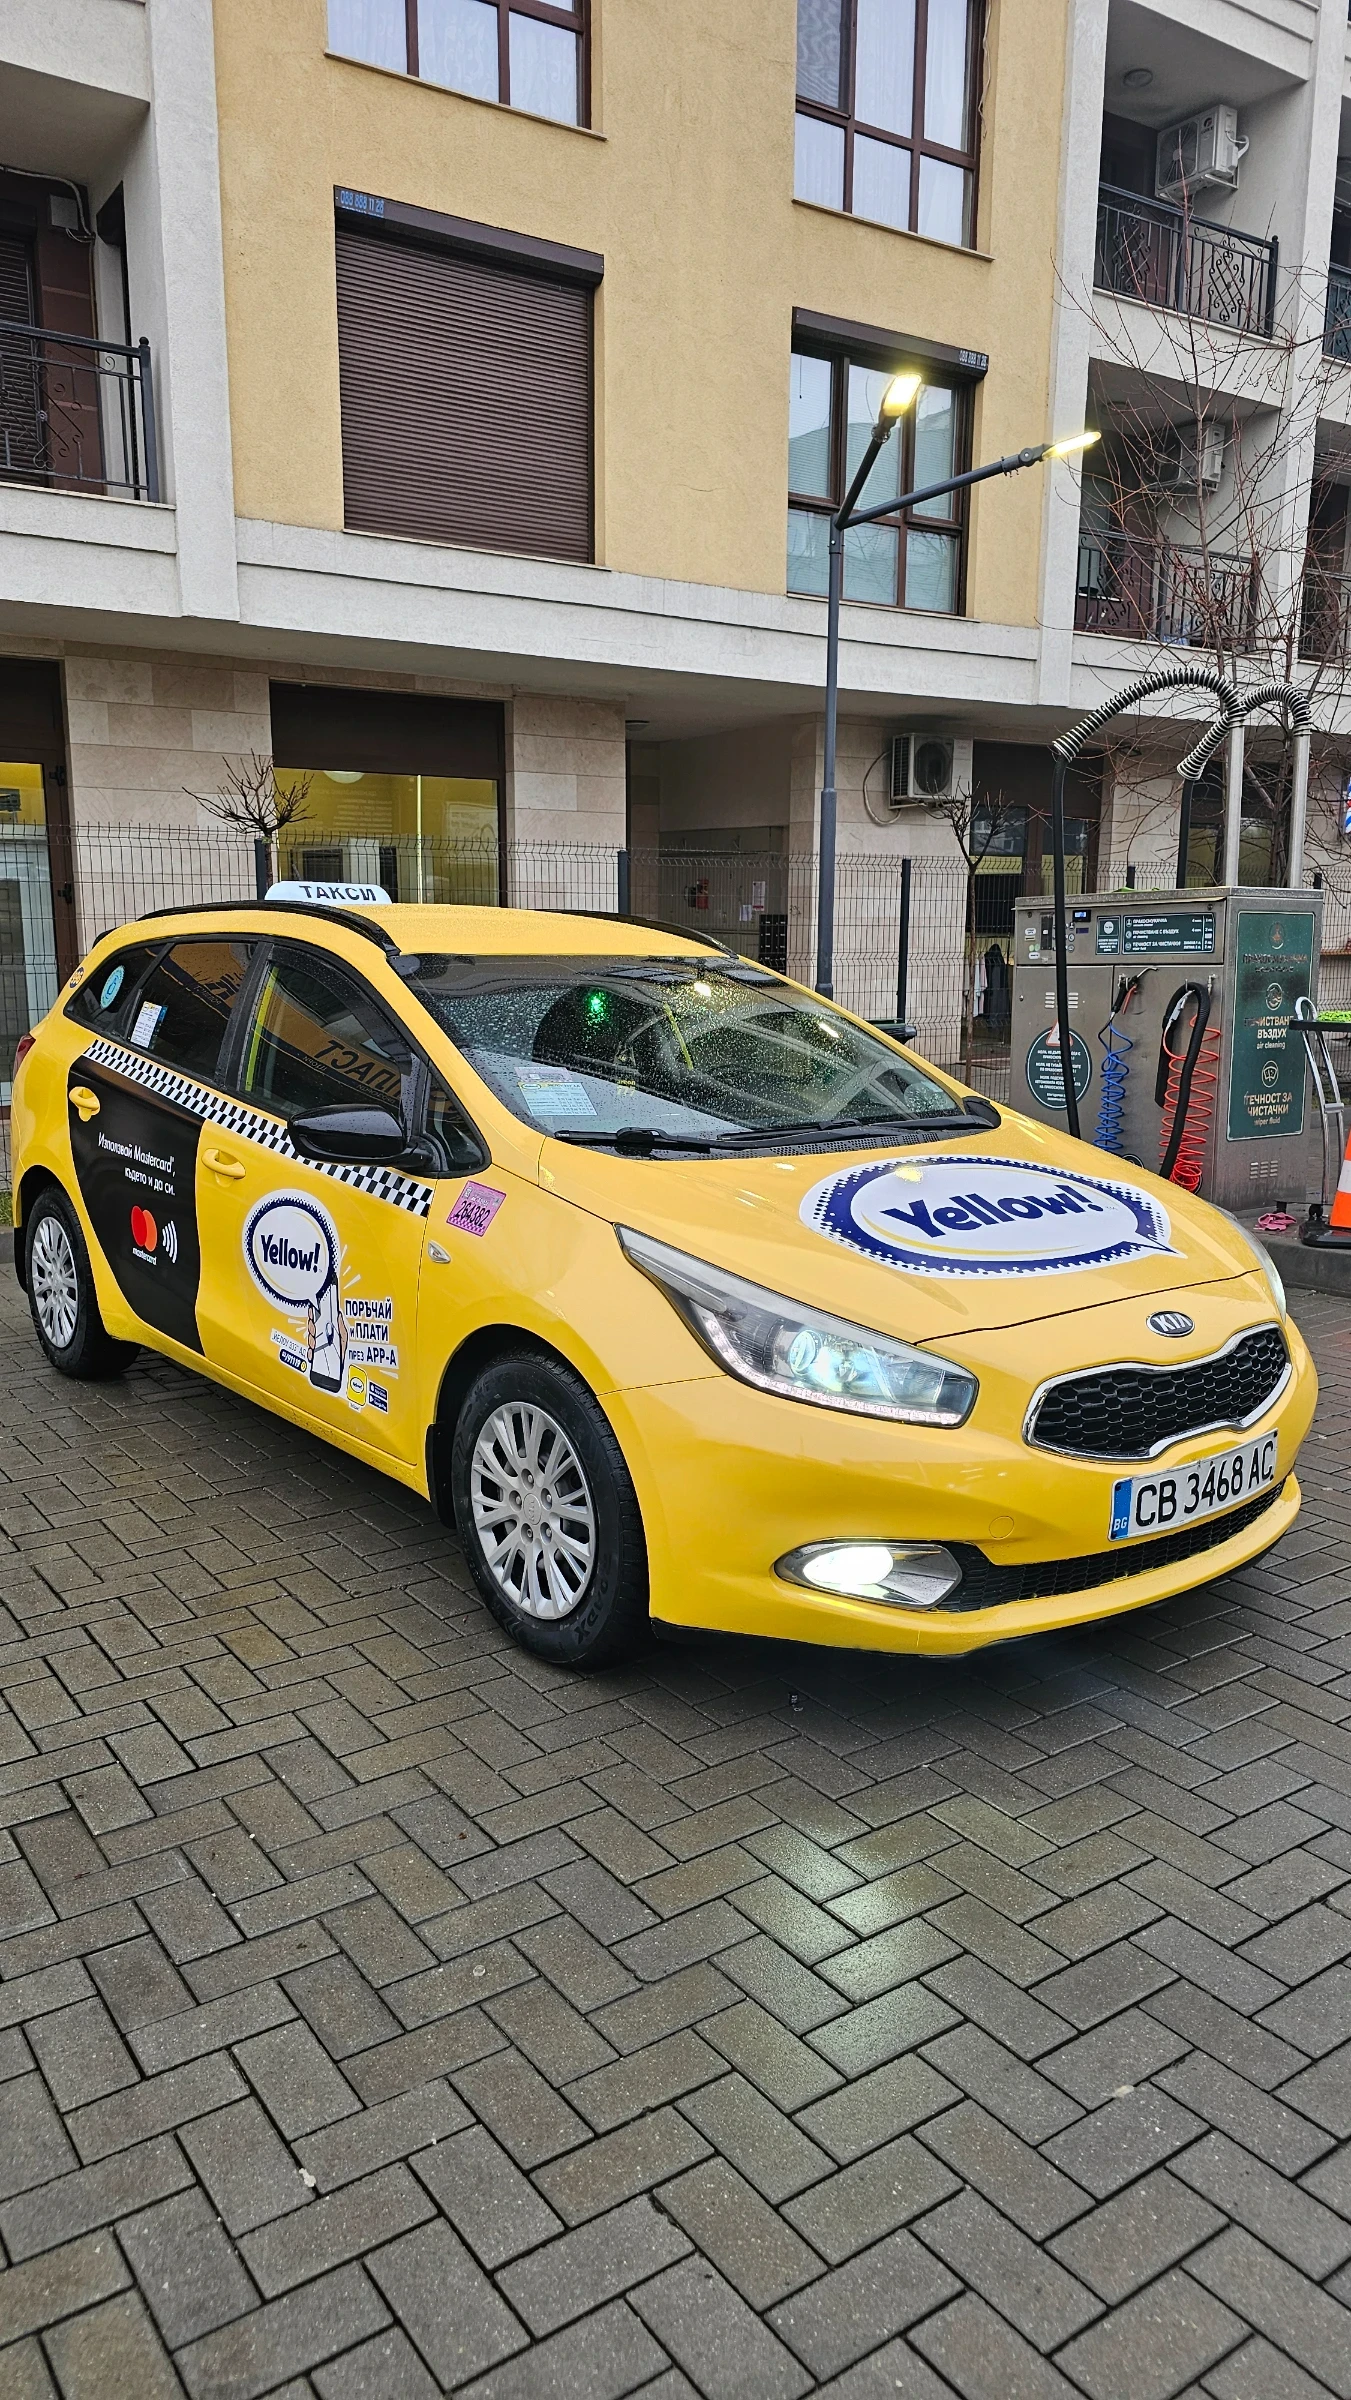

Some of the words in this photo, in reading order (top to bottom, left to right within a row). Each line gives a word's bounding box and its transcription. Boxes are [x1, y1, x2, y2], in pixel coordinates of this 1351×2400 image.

[299, 885, 377, 901] ТАКСИ
[1257, 1028, 1287, 1040] ВЪЗДУХ
[1265, 1040, 1286, 1050] cleaning
[1244, 1093, 1281, 1105] ТЕЧНОСТ
[1282, 1092, 1292, 1102] ЗА
[1247, 1104, 1288, 1117] ЧИСТАЧКИ
[98, 1131, 133, 1159] Използвай
[125, 1166, 147, 1185] където
[148, 1176, 153, 1187] и
[154, 1178, 163, 1192] да
[164, 1184, 176, 1196] си.
[454, 1200, 491, 1228] 264382
[879, 1184, 1104, 1238] Yellow!
[132, 1247, 157, 1266] mastercard
[260, 1233, 321, 1274] Yellow!
[345, 1298, 392, 1320] ПОРЪЧАЙ
[350, 1327, 355, 1338] и
[356, 1322, 389, 1341] ПЛАТИ
[1152, 1312, 1193, 1332] KIA
[348, 1349, 365, 1362] ПРЕЗ
[1135, 1479, 1177, 1527] CB
[1183, 1455, 1244, 1514] 3468
[1248, 1440, 1274, 1489] AC
[1113, 1517, 1128, 1532] BG
